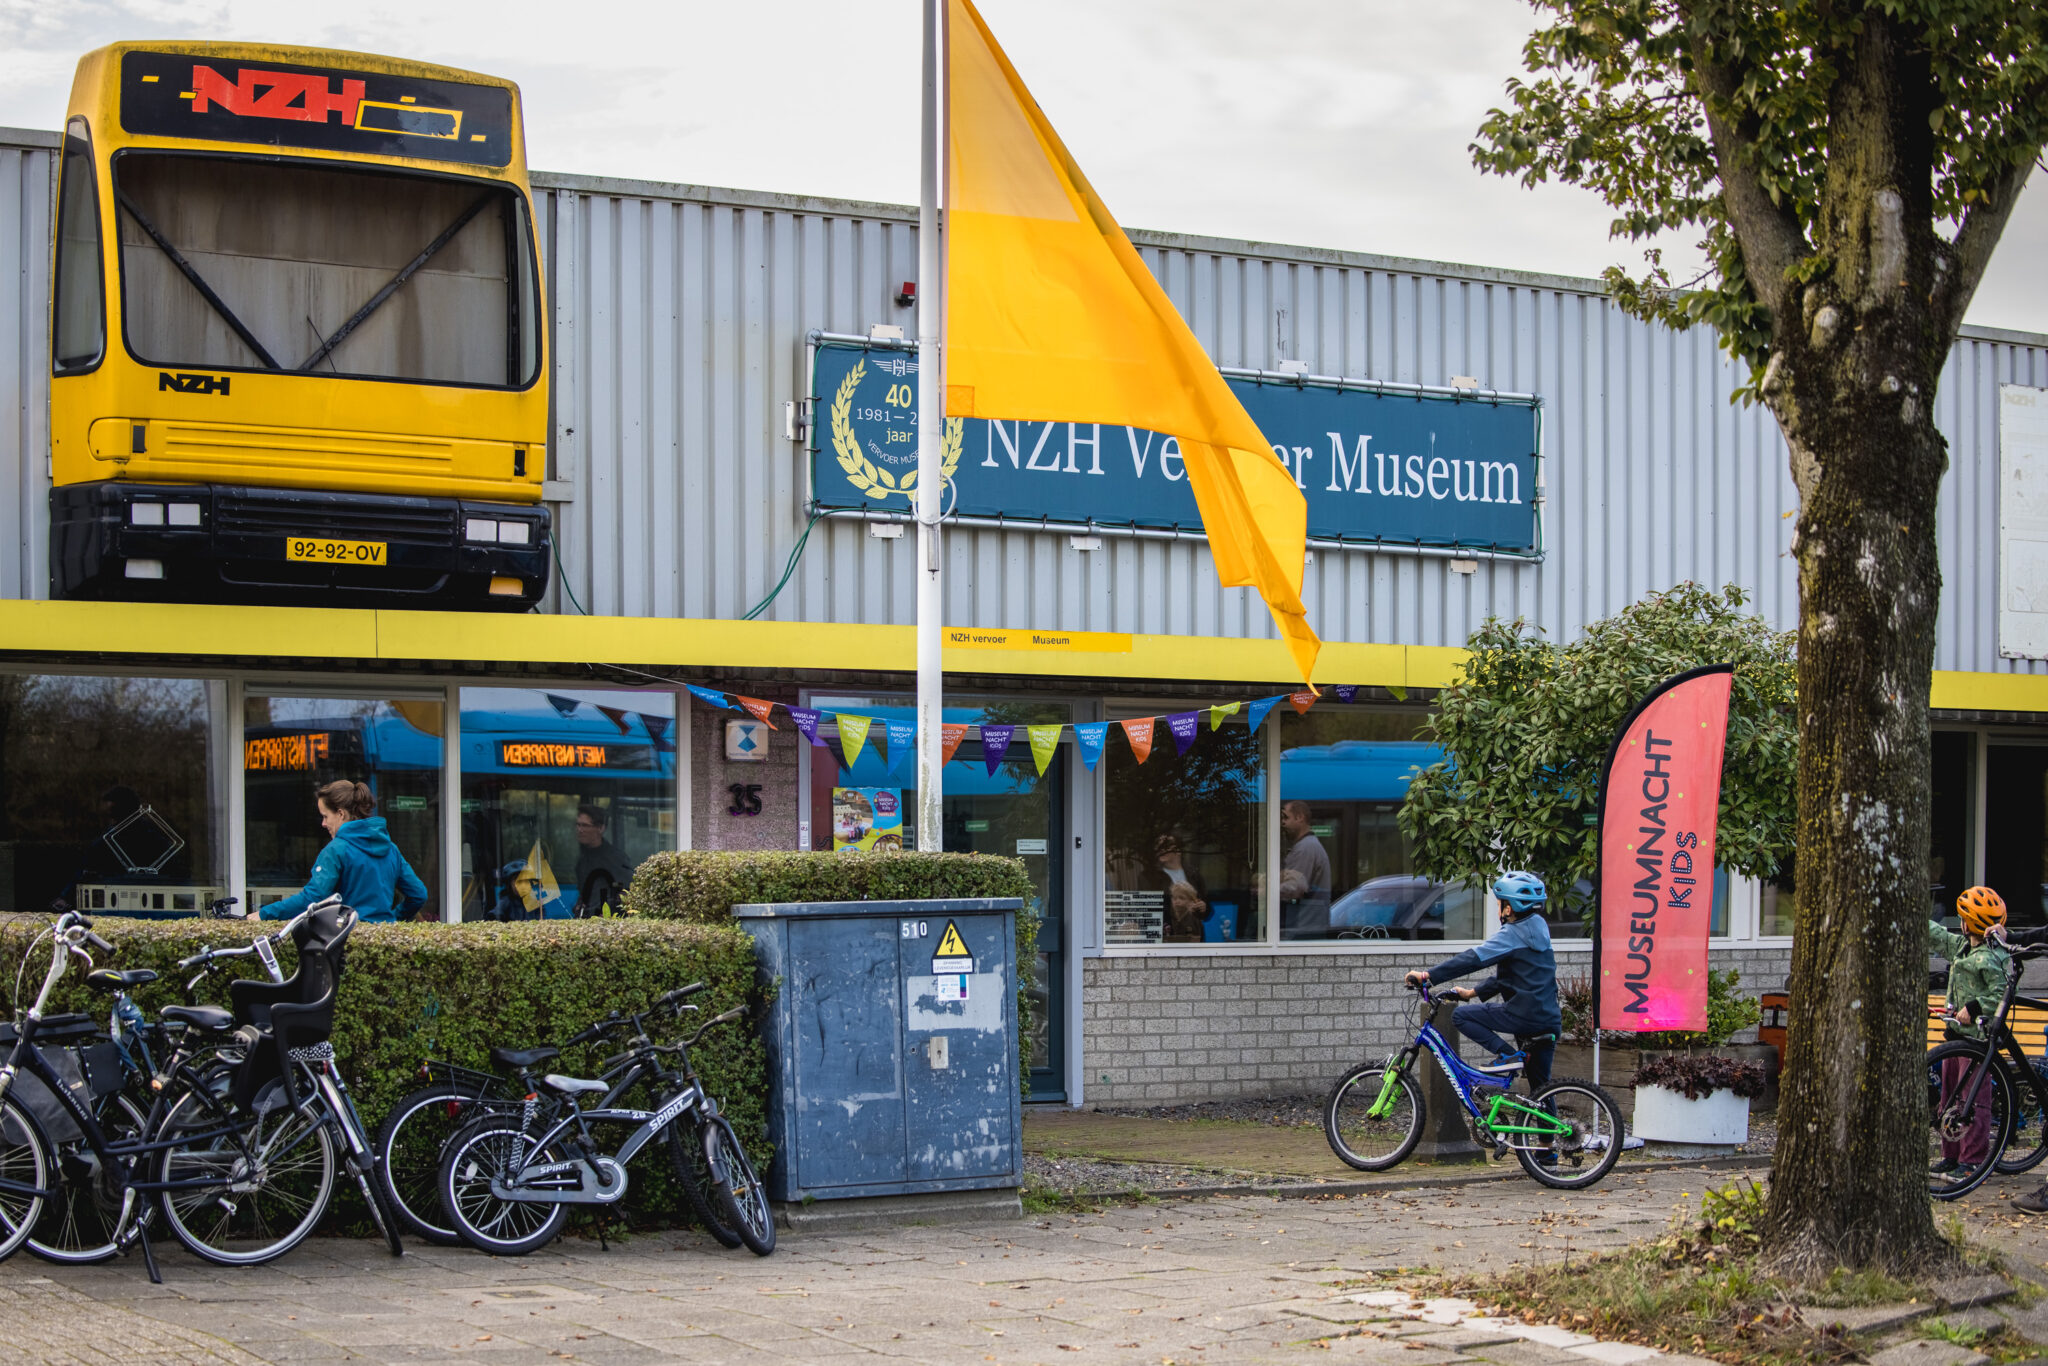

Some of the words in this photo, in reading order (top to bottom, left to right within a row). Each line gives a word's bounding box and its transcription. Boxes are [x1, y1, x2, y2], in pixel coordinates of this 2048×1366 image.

[192, 65, 366, 126] NZH
[159, 372, 231, 396] NZH
[885, 384, 912, 408] 40
[856, 408, 891, 422] 1981
[885, 428, 914, 444] jaar
[867, 439, 899, 465] VERVOER
[981, 419, 1105, 476] NZH
[1326, 432, 1523, 504] Museum
[294, 541, 382, 561] 92-92-OV
[950, 633, 970, 643] NZH
[972, 636, 1007, 644] vervoer
[1032, 635, 1070, 645] Museum
[791, 711, 817, 720] MUSEUM
[1172, 717, 1195, 726] MUSEUM
[1128, 723, 1151, 731] MUSEUM
[1130, 729, 1150, 737] NACHT
[729, 783, 763, 816] 35
[1623, 729, 1673, 1014] MUSEUMNACHT
[1667, 831, 1698, 908] KIDS
[902, 922, 928, 937] 510
[649, 1098, 685, 1131] SPIRIT
